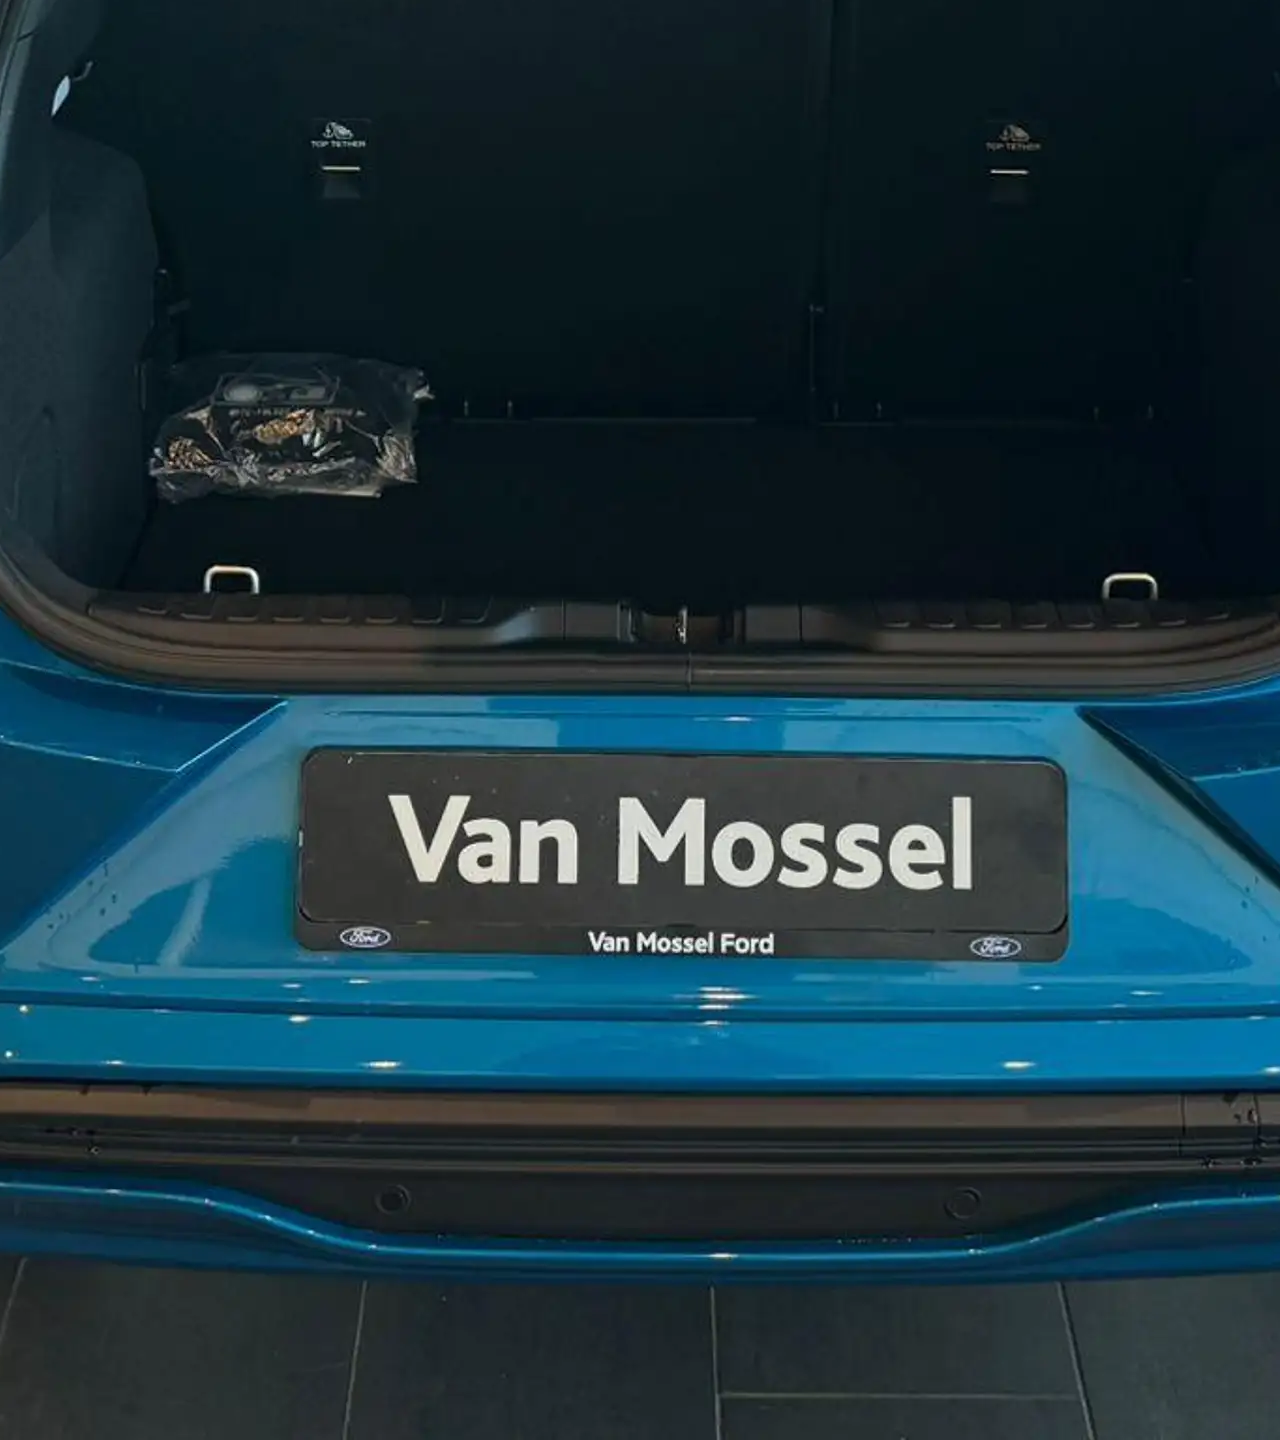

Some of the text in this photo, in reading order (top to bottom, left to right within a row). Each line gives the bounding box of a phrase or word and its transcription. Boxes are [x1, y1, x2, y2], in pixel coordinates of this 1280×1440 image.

[388, 794, 973, 890] Van Mossel
[588, 931, 775, 955] Van Mossel Ford
